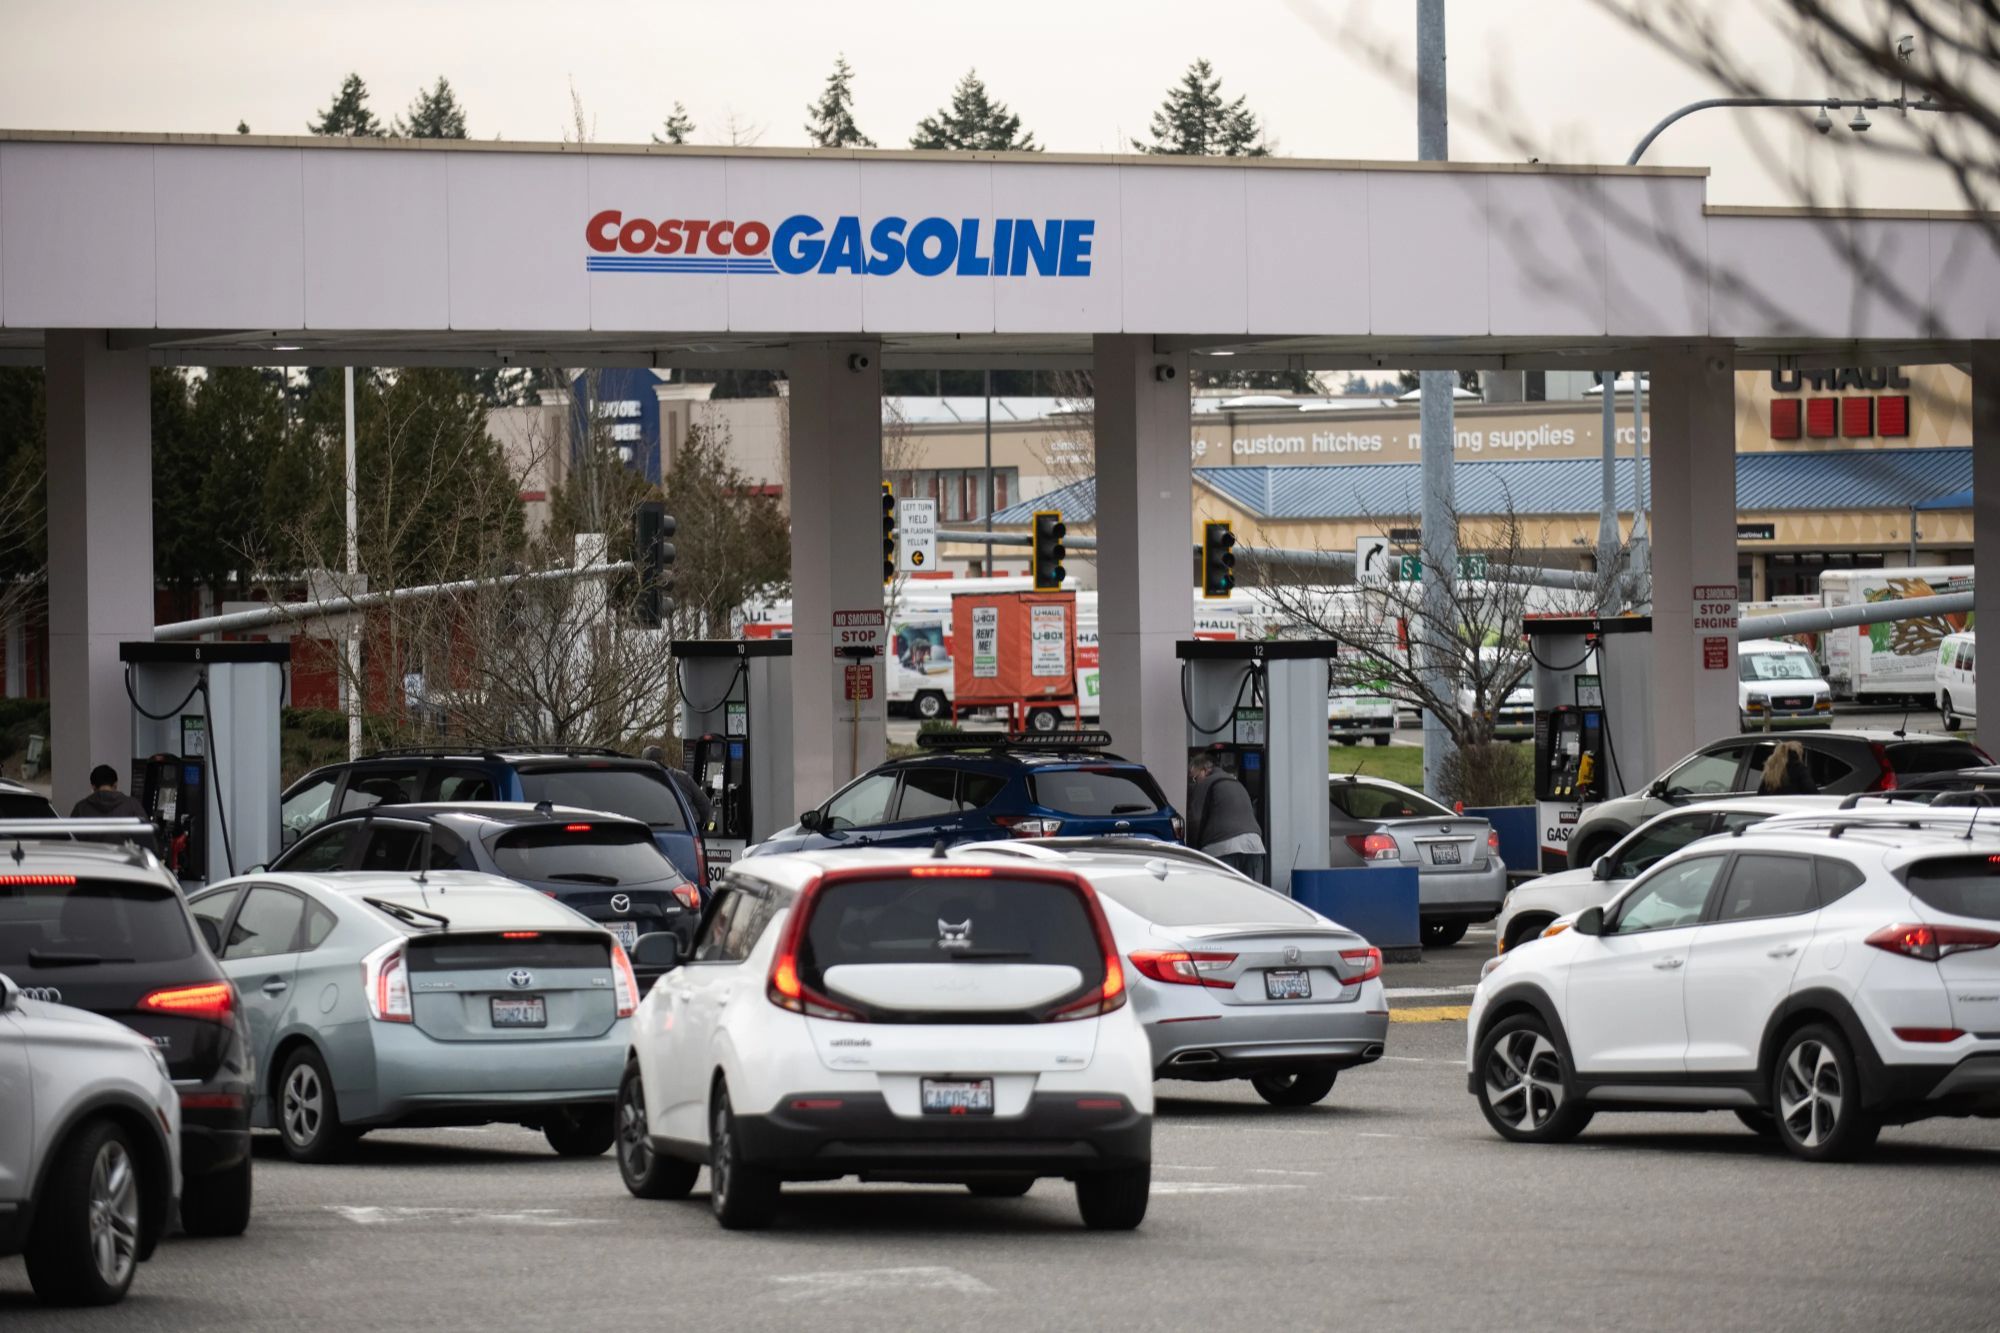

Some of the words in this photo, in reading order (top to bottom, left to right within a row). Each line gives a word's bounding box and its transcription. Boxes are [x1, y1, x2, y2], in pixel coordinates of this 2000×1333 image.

[586, 210, 770, 256] COSTCO
[772, 214, 1095, 276] GASOLINE
[1232, 434, 1305, 454] custom
[1312, 430, 1382, 452] hitches
[1489, 424, 1575, 450] supplies
[903, 503, 916, 511] LEFT
[918, 503, 932, 511] TURN
[908, 514, 928, 524] YIELD
[907, 538, 928, 546] YELLOW
[1361, 575, 1383, 584] ONLY
[1700, 604, 1731, 614] STOP
[835, 613, 846, 625] NO
[848, 613, 881, 625] SMOKING
[1694, 618, 1737, 628] ENGINE
[1592, 620, 1600, 631] 14
[841, 630, 876, 642] STOP
[975, 628, 994, 639] RENT
[1033, 631, 1063, 640] U-BOX
[737, 643, 745, 654] 10
[978, 641, 992, 650] ME!
[1254, 644, 1264, 656] 12
[195, 647, 201, 660] 8
